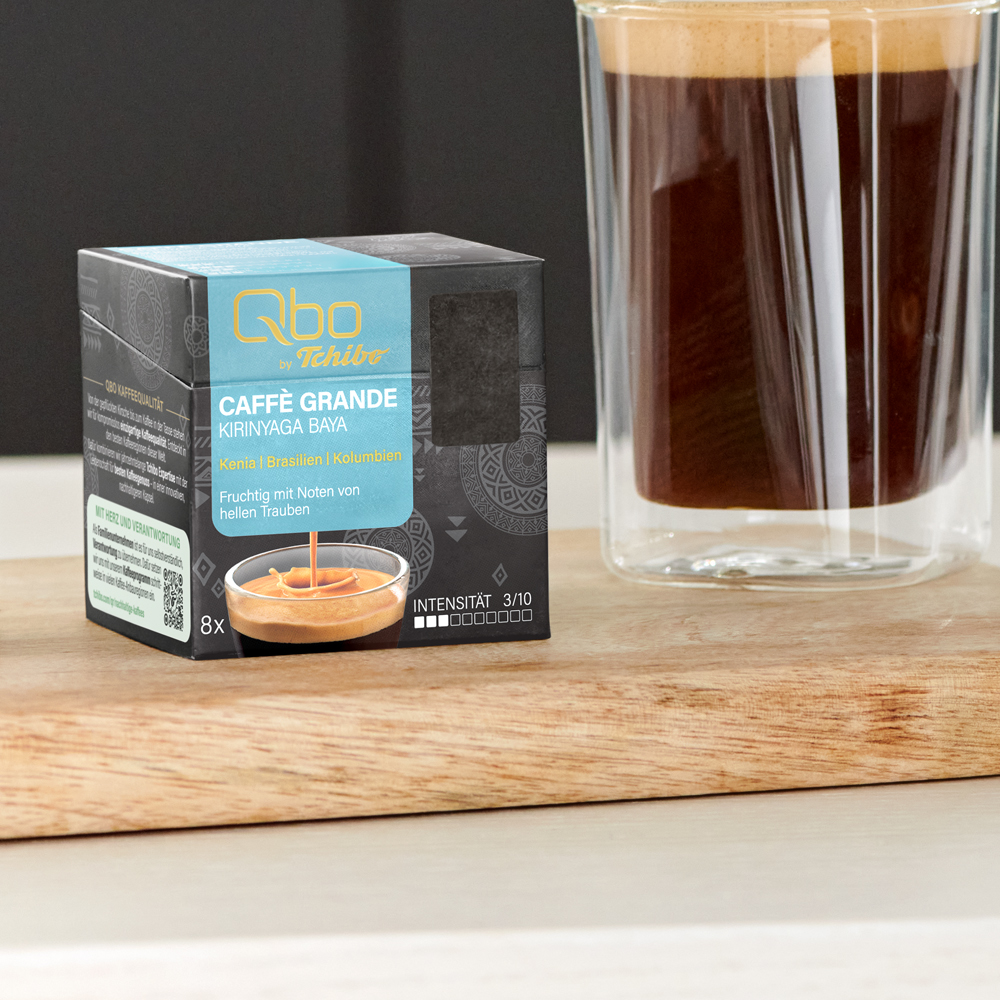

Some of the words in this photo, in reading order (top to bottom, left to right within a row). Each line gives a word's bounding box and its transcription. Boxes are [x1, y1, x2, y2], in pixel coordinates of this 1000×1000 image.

[234, 287, 361, 346] Qbo
[280, 360, 292, 370] by
[296, 344, 390, 367] Tchibo
[105, 380, 117, 394] QBO
[118, 383, 164, 412] KAFFEEQUALITÄT
[219, 389, 293, 416] CAFFÈ
[300, 388, 397, 411] GRANDE
[220, 419, 303, 438] KIRINYAGA
[310, 416, 347, 433] BAYA
[220, 458, 255, 470] Kenia
[268, 454, 322, 467] Brasilien
[334, 449, 401, 464] Kolumbien
[220, 489, 269, 503] Fruchtig
[275, 488, 293, 500] mit
[298, 487, 333, 498] Noten
[338, 487, 359, 496] von
[221, 507, 256, 519] hellen
[260, 504, 309, 517] Trauben
[95, 505, 104, 518] MIT
[105, 510, 118, 525] HERZ
[120, 515, 131, 529] UND
[132, 520, 180, 549] VERANTWORTUNG
[414, 595, 491, 612] INTENSITÄT
[504, 592, 531, 606] 3/10
[201, 615, 224, 634] 8x
